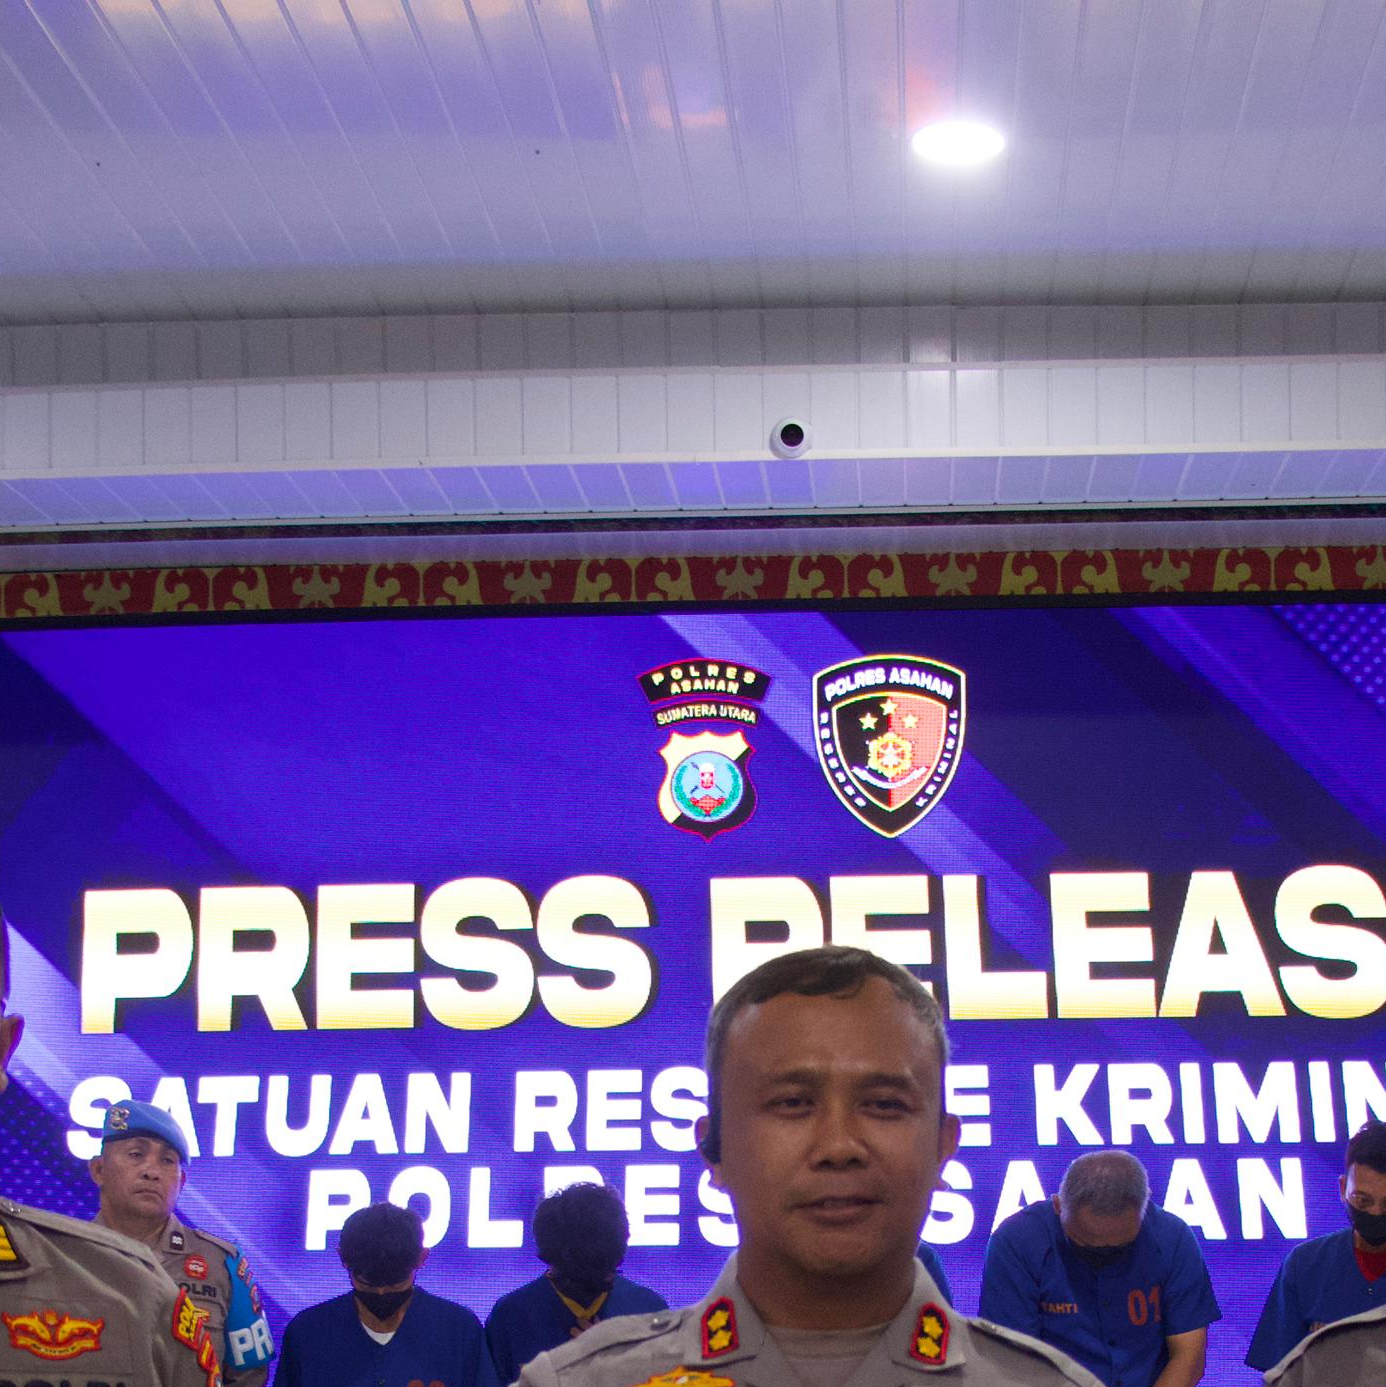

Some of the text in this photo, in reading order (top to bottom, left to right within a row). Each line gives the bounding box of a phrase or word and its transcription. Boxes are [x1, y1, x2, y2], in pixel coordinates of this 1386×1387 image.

[652, 664, 756, 686] POLRES
[670, 679, 739, 695] ASAHAN
[824, 667, 954, 701] POLRES ASAHAN
[656, 703, 757, 725] SUMATERA UTARA
[80, 874, 653, 1035] PRESS
[513, 1063, 992, 1154] RESE
[304, 1156, 1310, 1251] POLES SAAN
[179, 1281, 217, 1298] OLRI
[1043, 1301, 1078, 1314] TAHTI
[1127, 1285, 1162, 1326] 01
